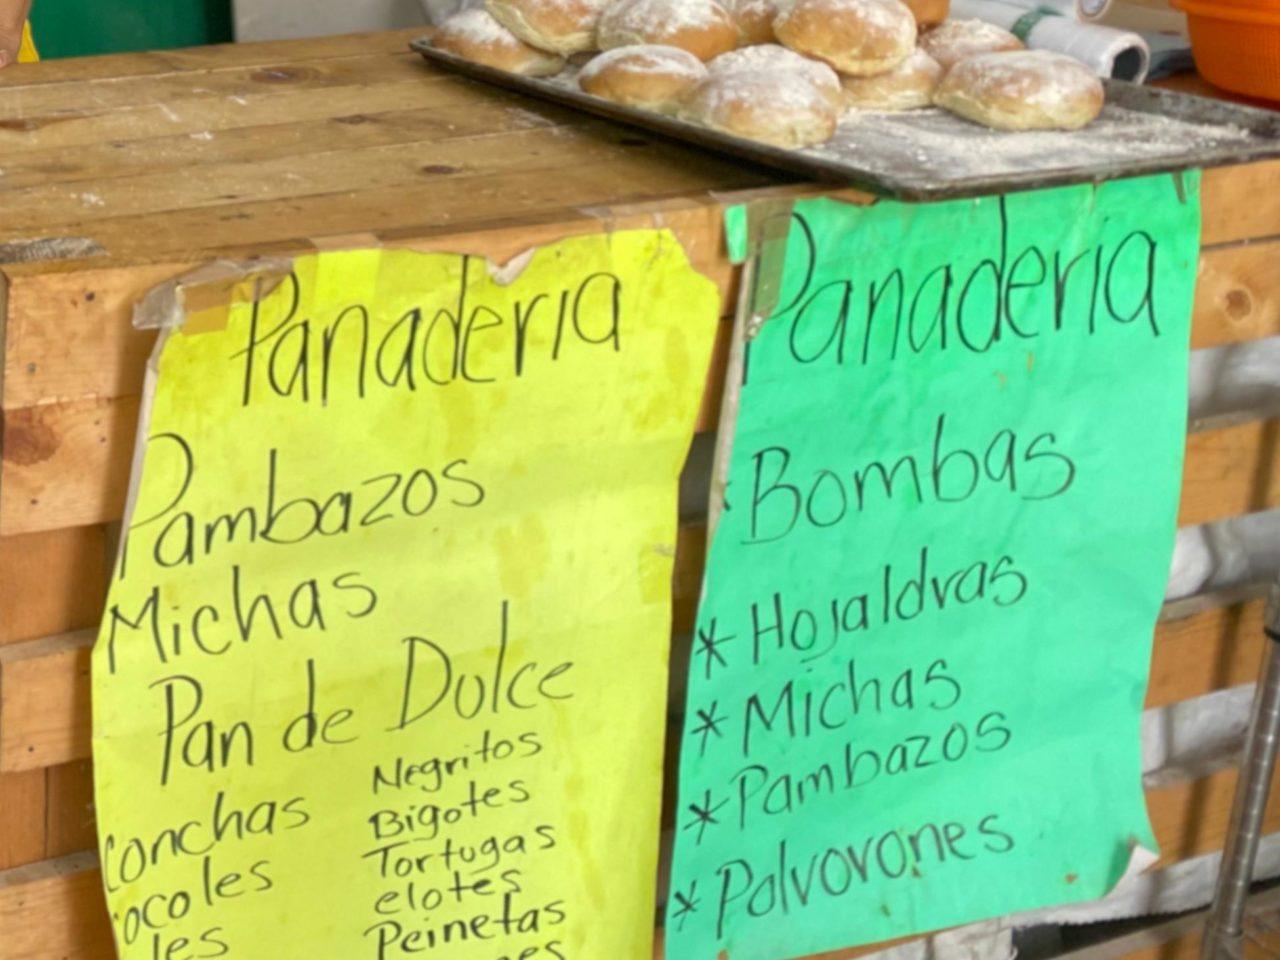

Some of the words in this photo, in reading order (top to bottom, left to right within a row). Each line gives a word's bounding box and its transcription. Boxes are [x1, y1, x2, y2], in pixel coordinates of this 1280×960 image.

[121, 432, 486, 580] Pambazos
[740, 413, 1075, 545] Bombas
[107, 564, 379, 675] Michas
[750, 546, 1029, 666] Hojaldras
[148, 674, 255, 787] Pan
[282, 658, 361, 753] de
[384, 599, 576, 733] Dulce
[742, 656, 962, 757] Michas
[367, 779, 531, 841] Bigotes
[372, 729, 543, 796] Negritos
[730, 711, 1012, 830] Pambazos
[104, 791, 311, 894] Conchas
[361, 824, 557, 879] Tortugas
[374, 868, 522, 916] elotes
[715, 814, 1015, 941] Polvorones
[113, 855, 274, 946] ocoles
[363, 892, 567, 960] Peinetas
